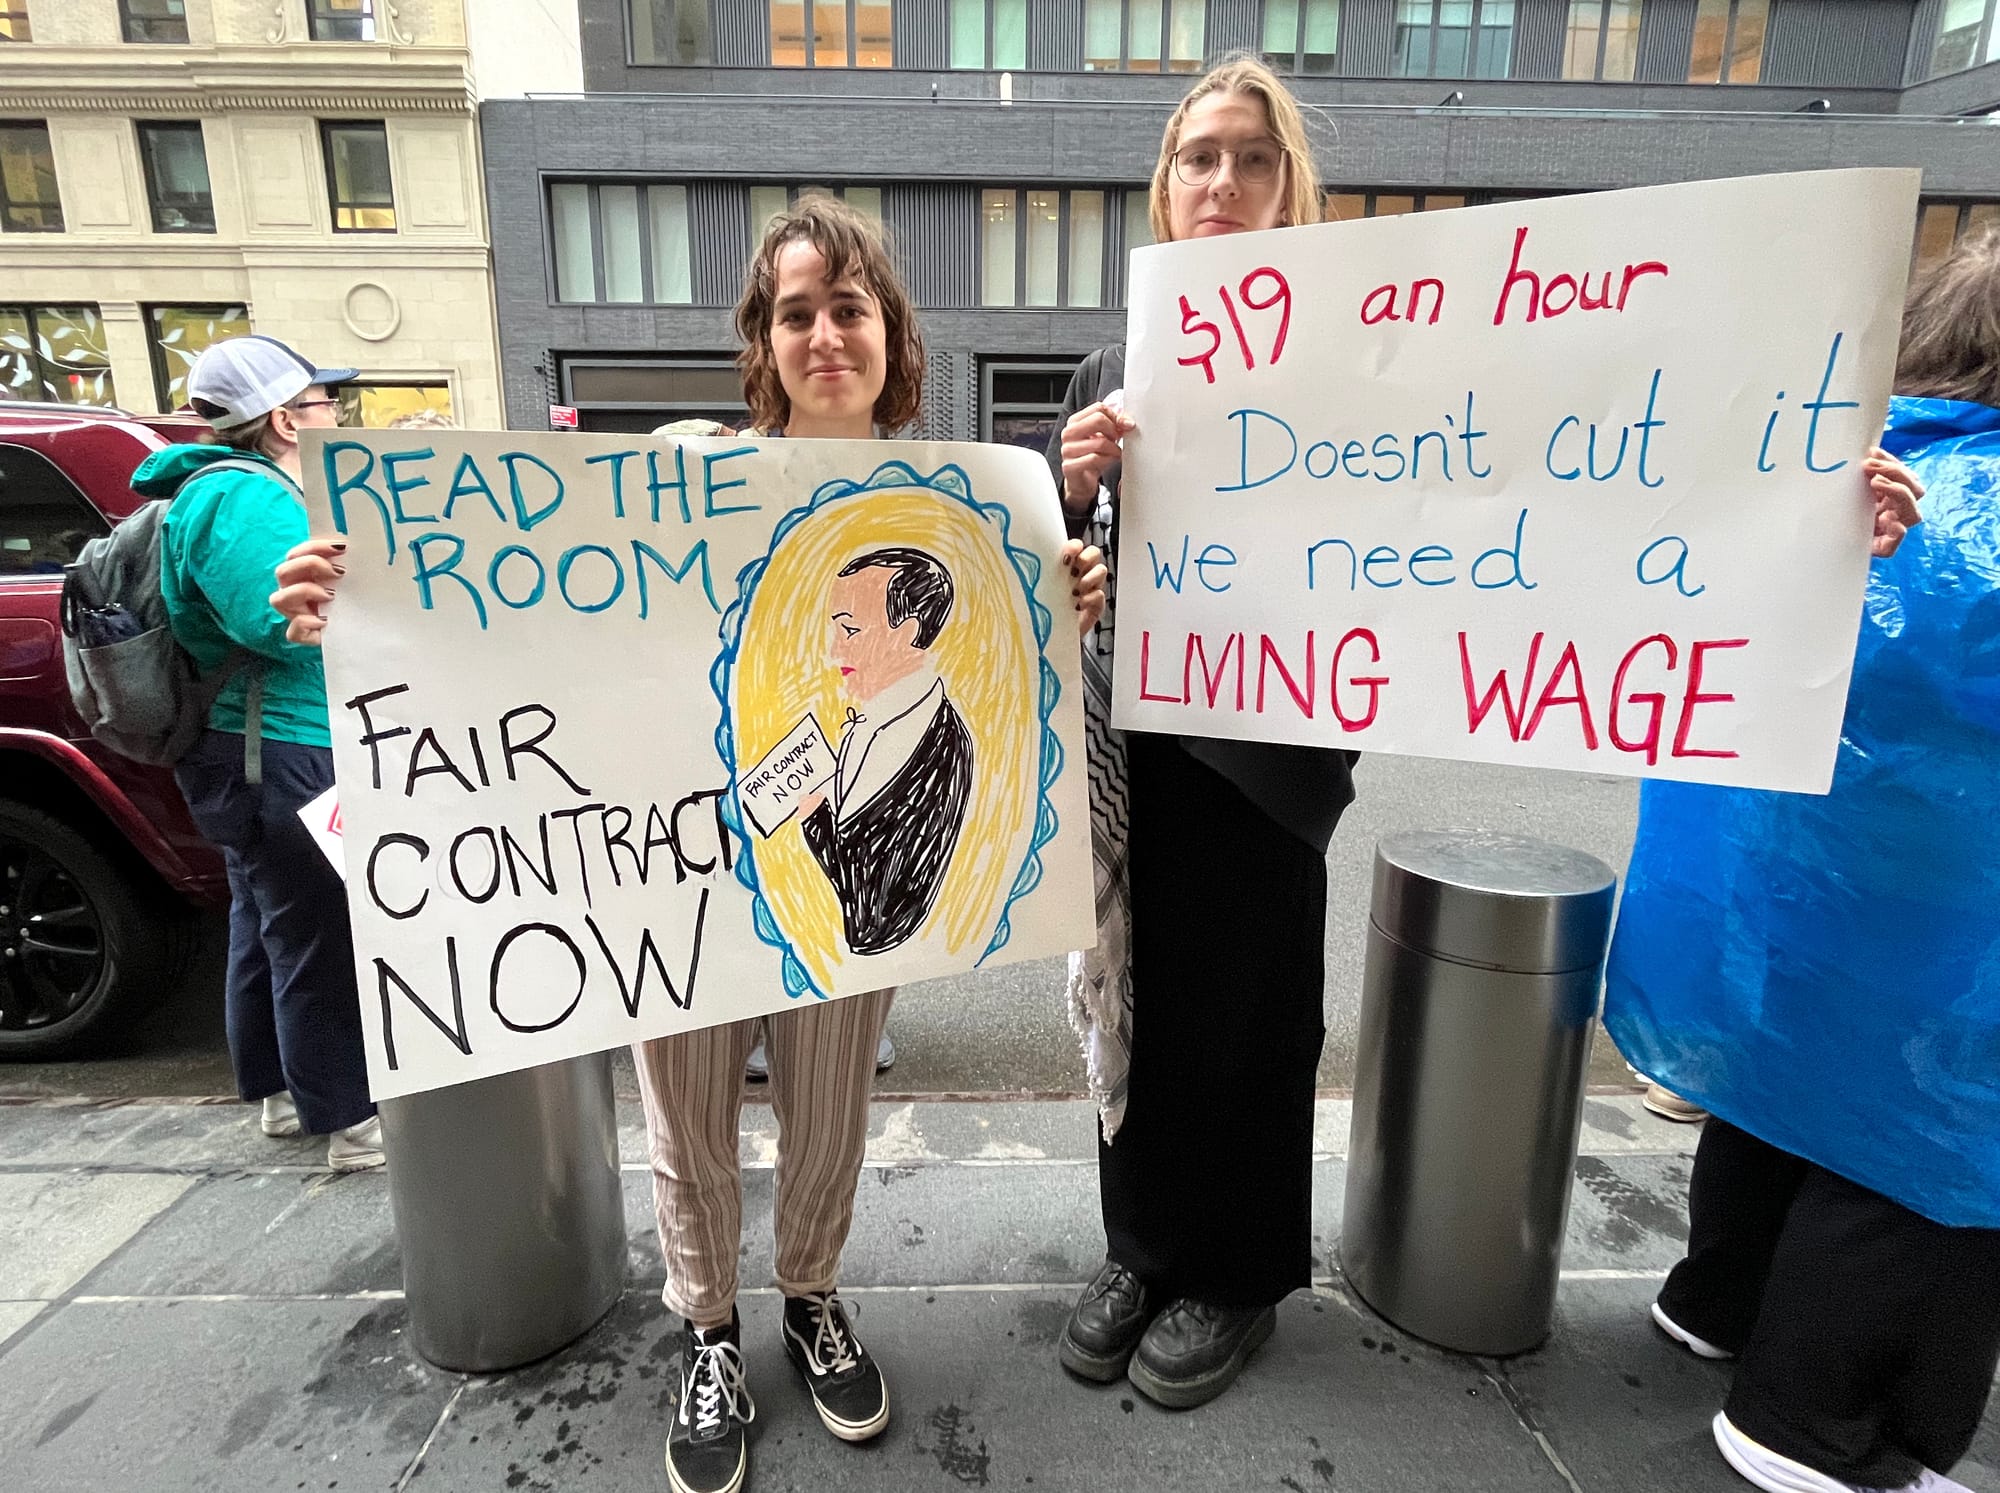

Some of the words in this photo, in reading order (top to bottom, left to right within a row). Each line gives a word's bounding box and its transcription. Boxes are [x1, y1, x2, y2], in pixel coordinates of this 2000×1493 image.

[1177, 266, 1292, 384] $19
[1360, 278, 1445, 326] an
[1493, 226, 1668, 326] hour
[1215, 390, 1492, 492] Doesn't
[1546, 368, 1666, 488] cut
[1757, 332, 1860, 473] it
[323, 440, 566, 565] READ
[584, 444, 762, 523] THE
[1308, 508, 1538, 591] need
[1636, 536, 1706, 597] a
[408, 532, 722, 630] ROOM
[345, 683, 592, 797] FAIR
[1139, 627, 1390, 733] LIVING
[1457, 631, 1751, 766] WAGE
[745, 770, 776, 798] FAIR
[773, 731, 818, 774] CONTRACT
[772, 758, 814, 803] NOW
[367, 788, 733, 920] CONTRACT
[372, 887, 710, 1071] NOW
